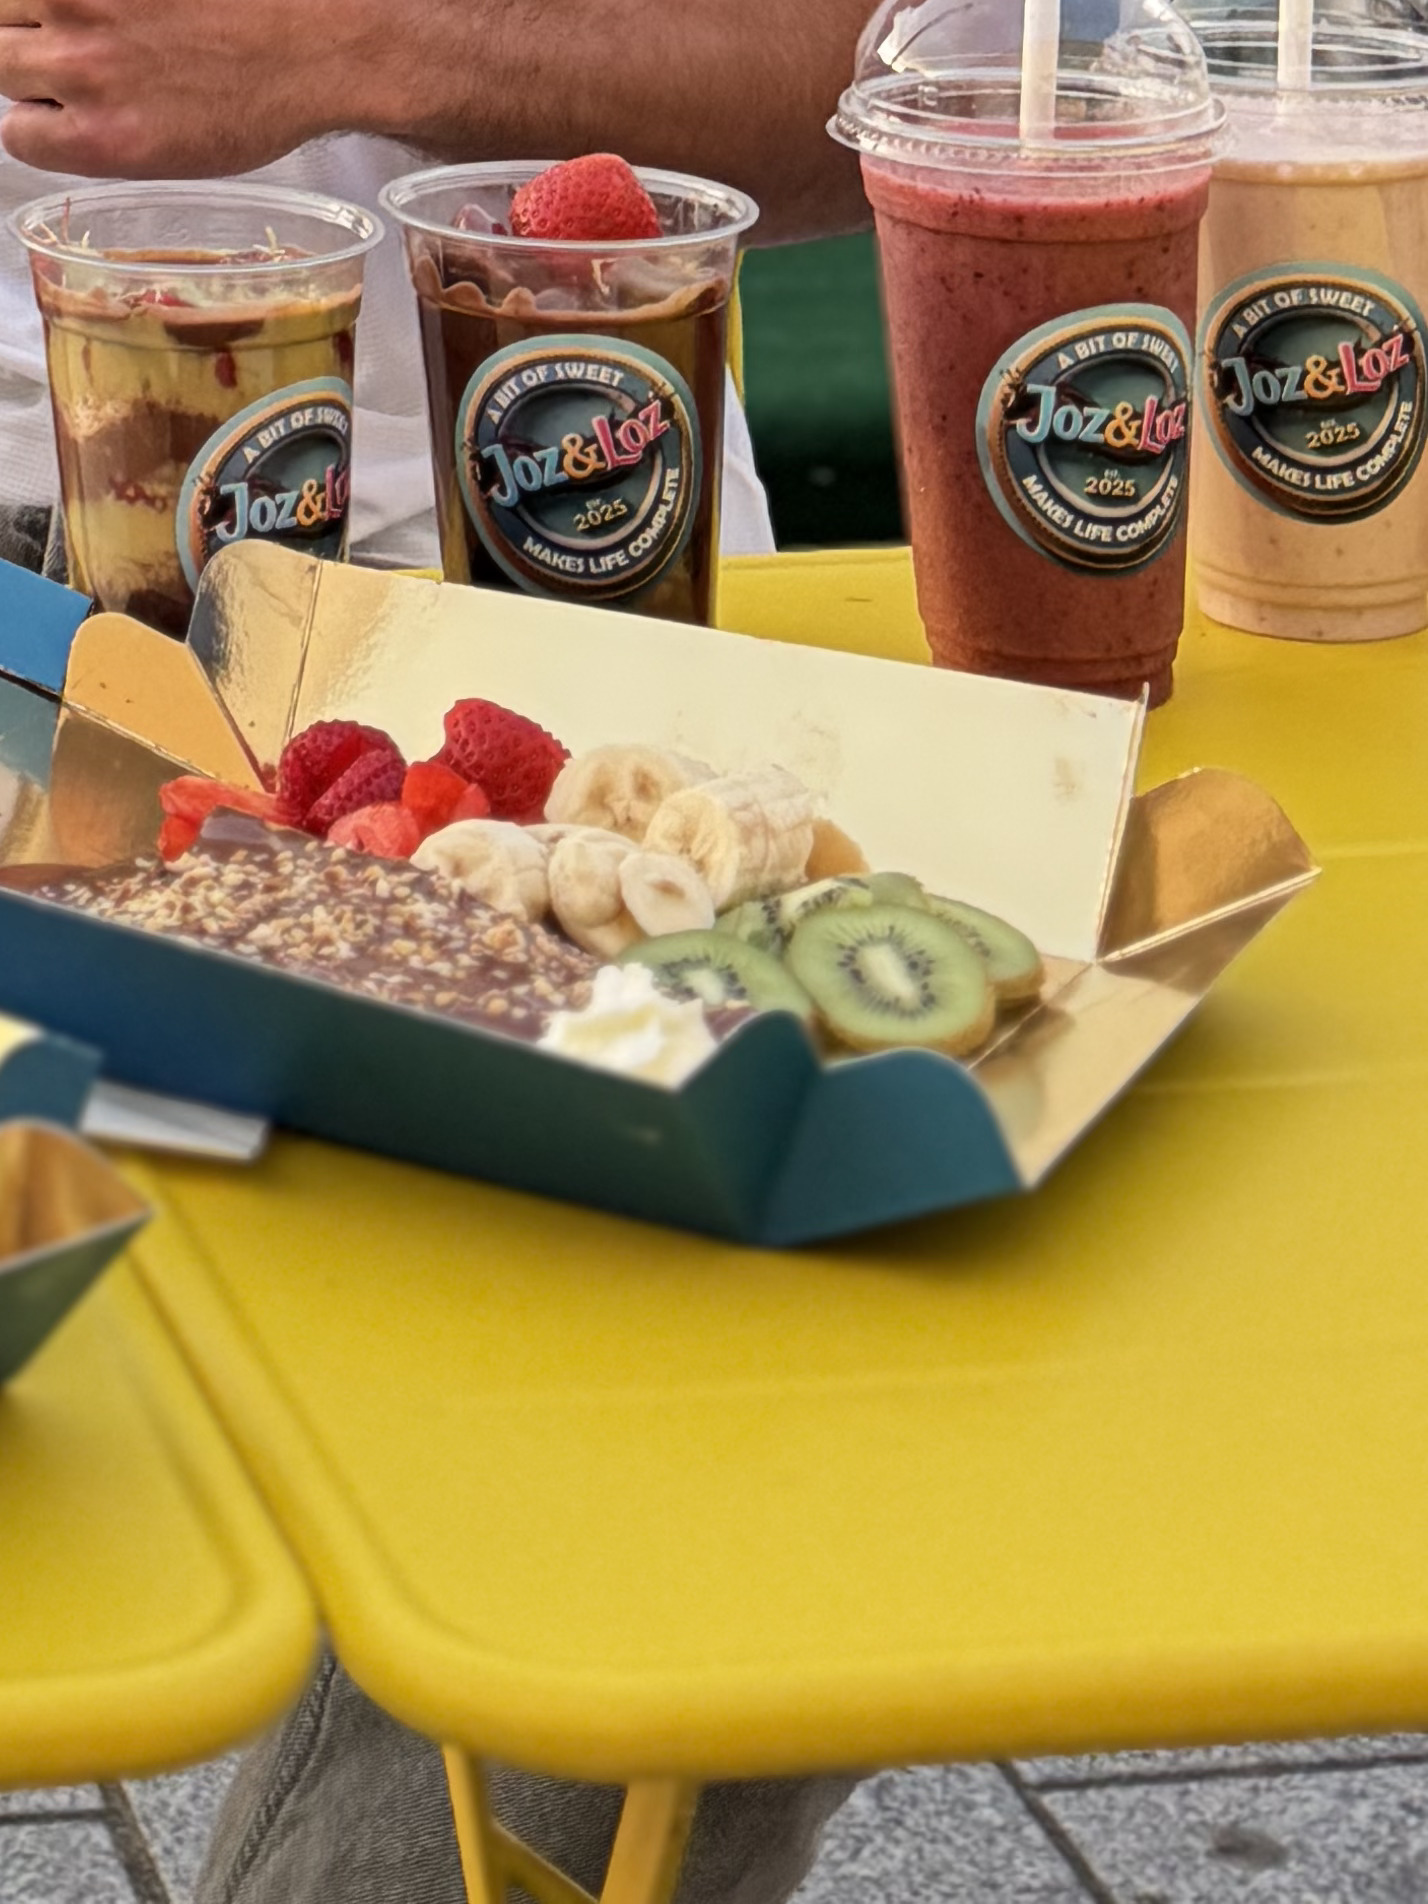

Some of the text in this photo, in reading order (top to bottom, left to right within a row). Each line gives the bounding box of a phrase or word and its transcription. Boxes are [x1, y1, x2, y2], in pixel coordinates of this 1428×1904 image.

[1232, 287, 1376, 340] A BIT OF SWEET
[1057, 352, 1075, 370] A
[1074, 335, 1107, 359] BIT
[1112, 331, 1140, 349] OF
[486, 362, 624, 425] A BIT OF SWEET
[243, 446, 260, 463] A
[257, 419, 286, 448] BIT
[290, 407, 314, 429] OF
[1251, 400, 1413, 490] MAKES LIFE COMPLETE
[1305, 422, 1360, 450] 2025
[1022, 473, 1179, 542] MAKES LIFE COMPLETE
[1084, 476, 1136, 497] 2025
[523, 468, 680, 574] MAKES LIFE COMPLETE
[573, 498, 628, 532] 2025
